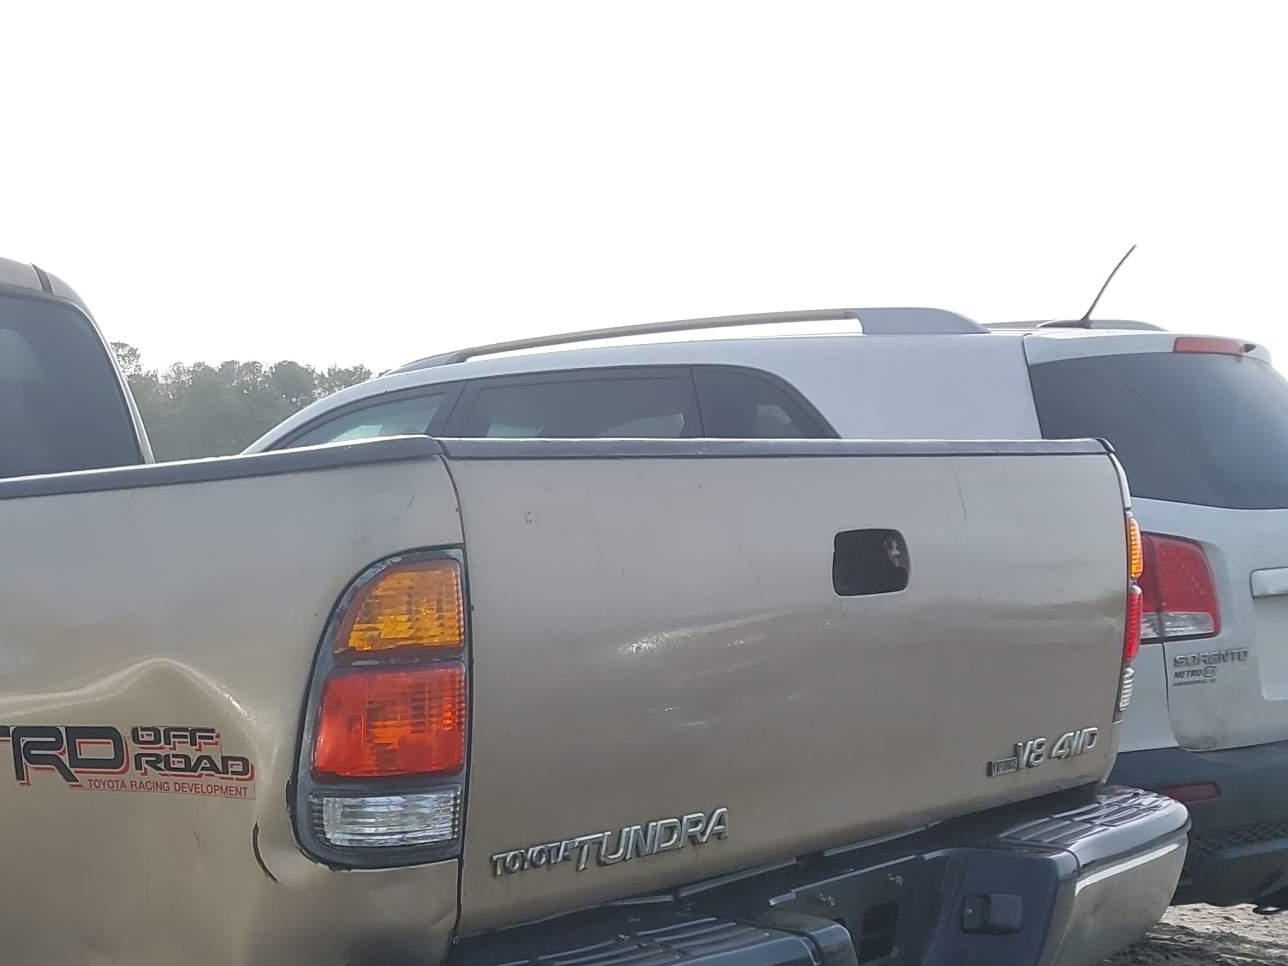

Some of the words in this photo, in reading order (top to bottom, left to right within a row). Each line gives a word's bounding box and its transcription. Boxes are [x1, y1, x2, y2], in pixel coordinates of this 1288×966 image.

[1176, 648, 1248, 668] SORENTO
[1173, 669, 1202, 679] METRO
[131, 726, 221, 750] OFF
[1014, 736, 1048, 769] V8
[134, 752, 255, 782] ROAD
[87, 779, 127, 791] TOYOTA
[130, 781, 170, 792] RACING
[174, 783, 249, 799] DEVELOPMENT
[491, 840, 573, 876] TOYOTA
[573, 807, 729, 872] TUNDRA
